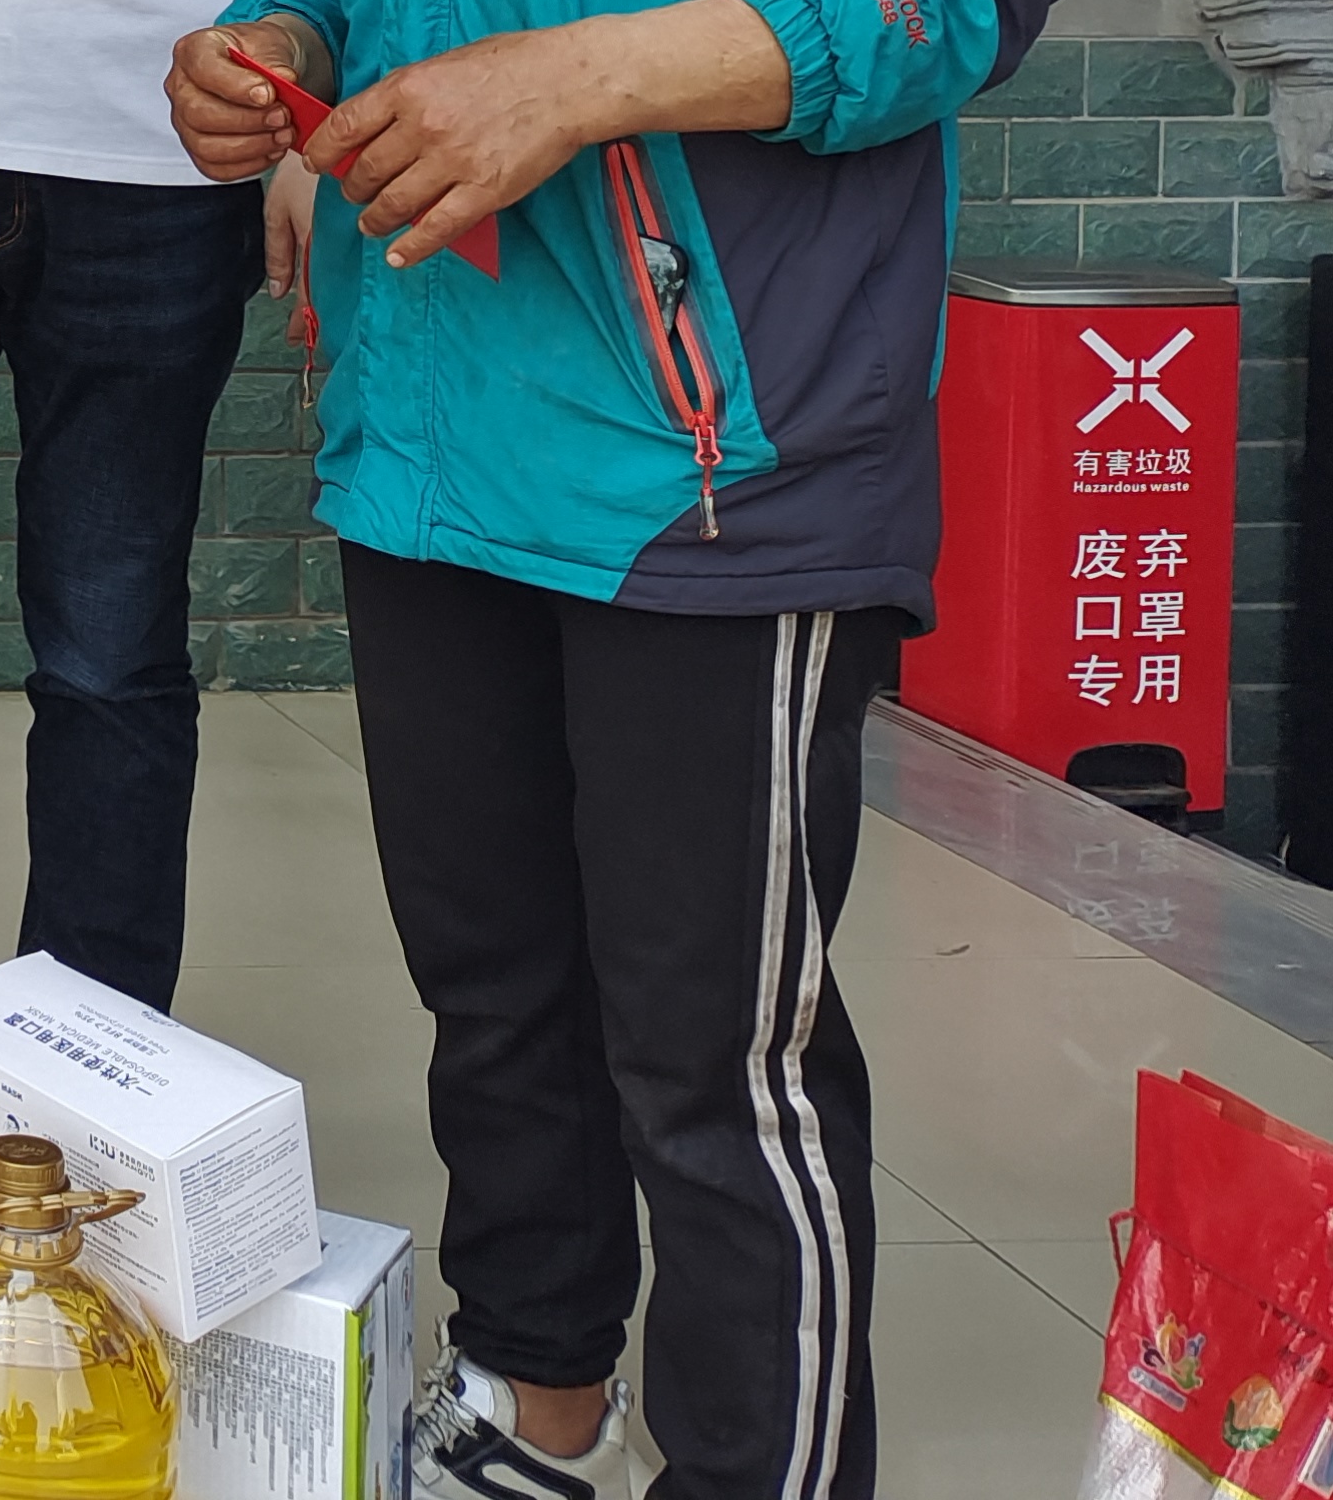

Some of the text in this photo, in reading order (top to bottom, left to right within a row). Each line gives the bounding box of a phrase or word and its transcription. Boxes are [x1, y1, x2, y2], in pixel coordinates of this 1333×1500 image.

[1073, 449, 1192, 477] 有害垃圾
[1073, 481, 1190, 493] Hazardous waste
[1071, 529, 1189, 579] 废弃
[1075, 592, 1186, 642] 口罩
[1068, 654, 1182, 706] 专用
[3, 1011, 154, 1097] 一次性使用医用口罩
